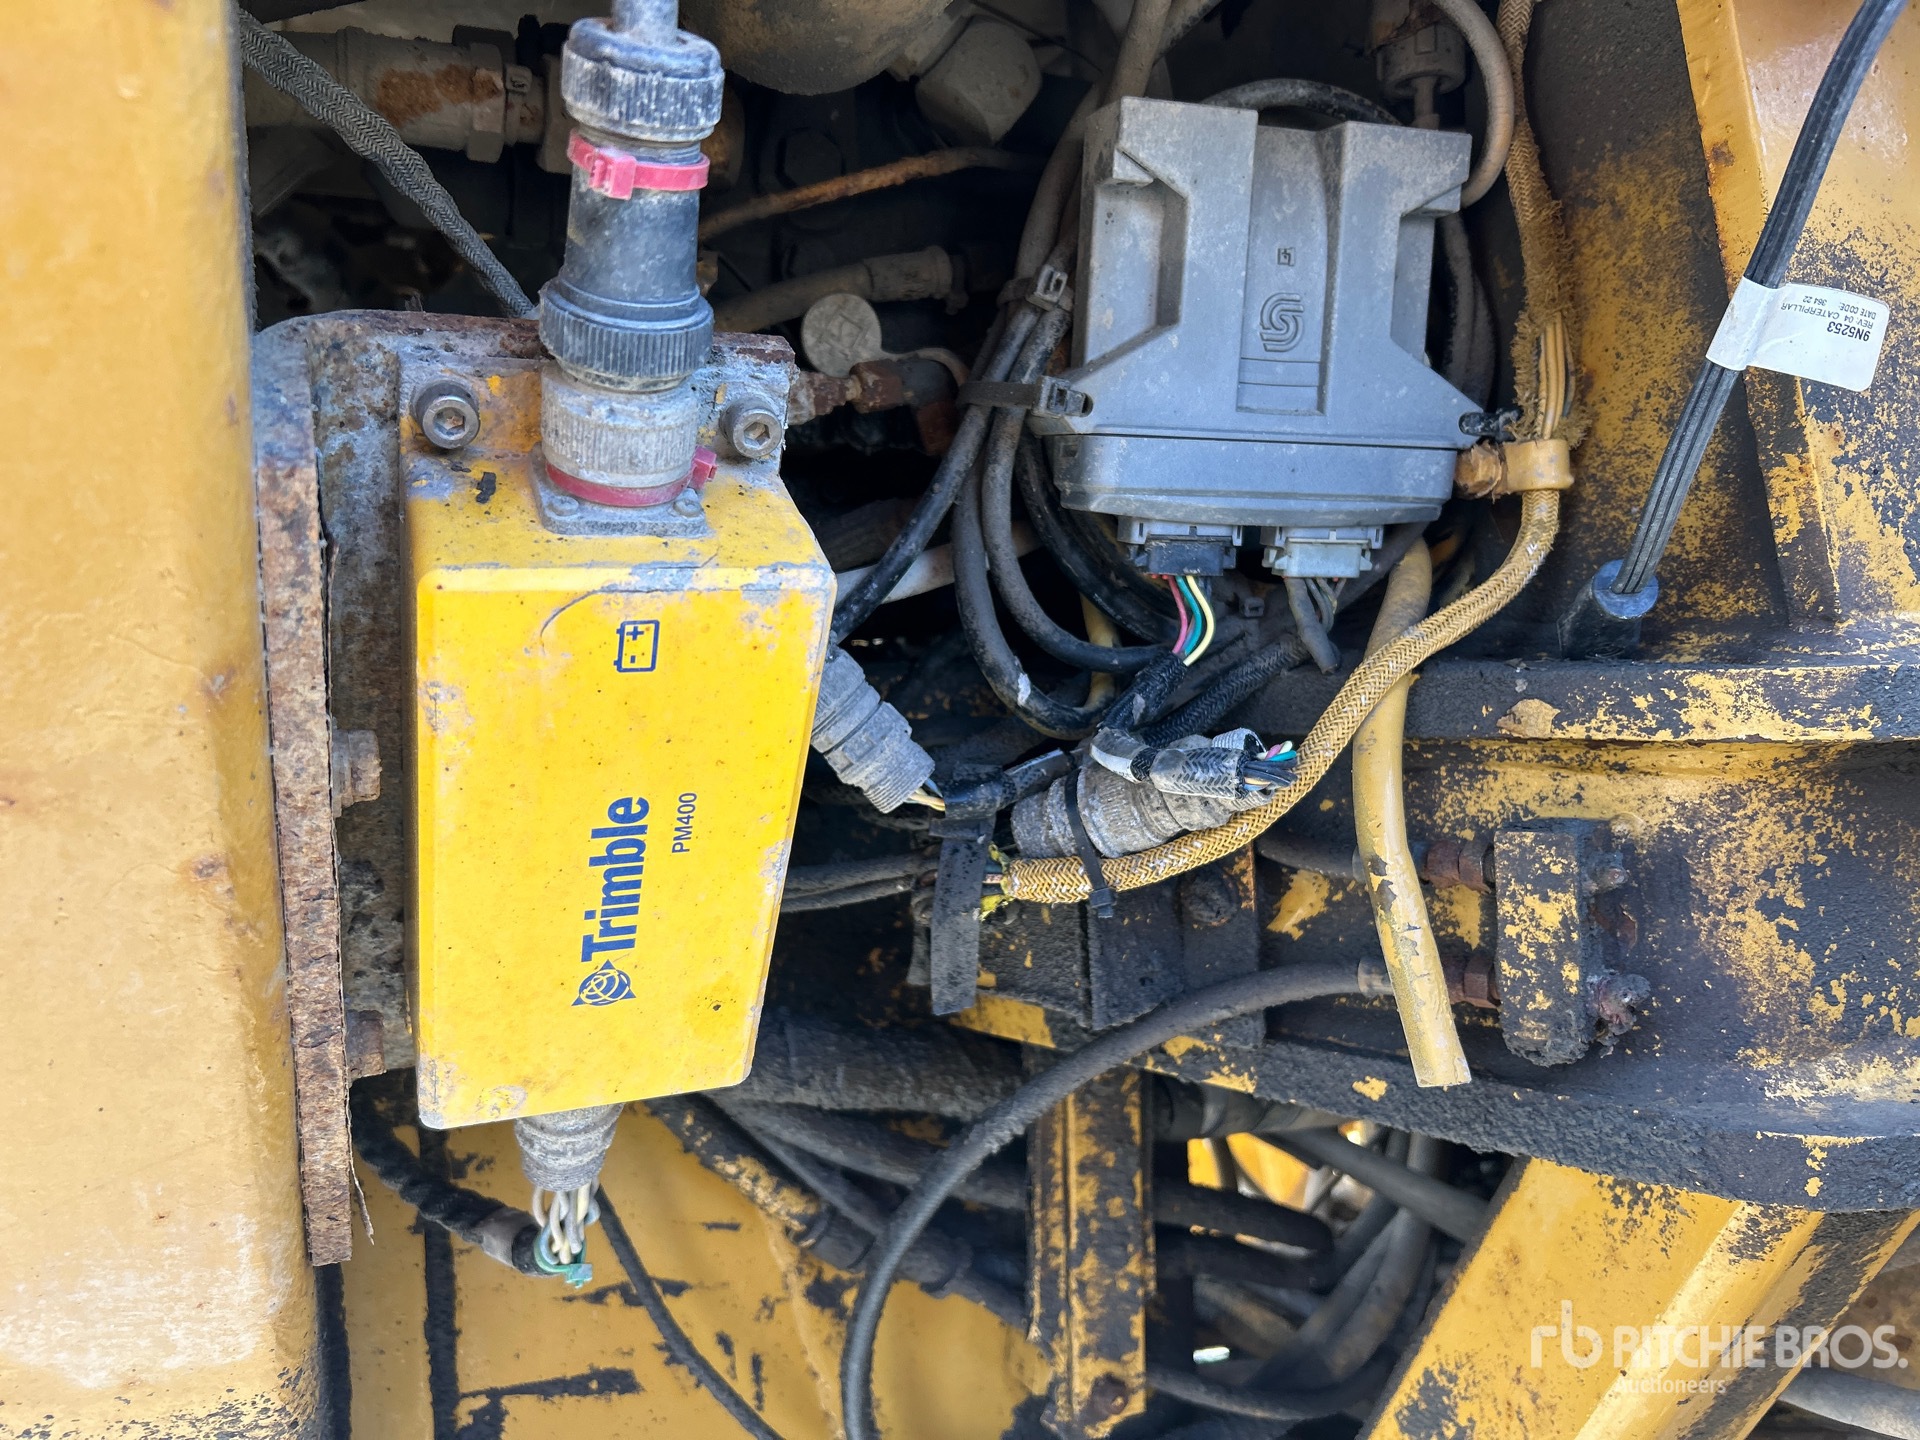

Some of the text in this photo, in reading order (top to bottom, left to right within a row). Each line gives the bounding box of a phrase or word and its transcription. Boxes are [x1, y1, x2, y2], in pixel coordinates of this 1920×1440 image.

[1802, 295, 1812, 303] 22
[1839, 302, 1859, 314] CODE:
[1780, 302, 1874, 329] REV: 04 CATERPILLAR
[1860, 308, 1877, 320] DATE
[1827, 321, 1871, 341] 9N5253
[671, 792, 697, 853] PM400
[581, 797, 650, 962] Trimble
